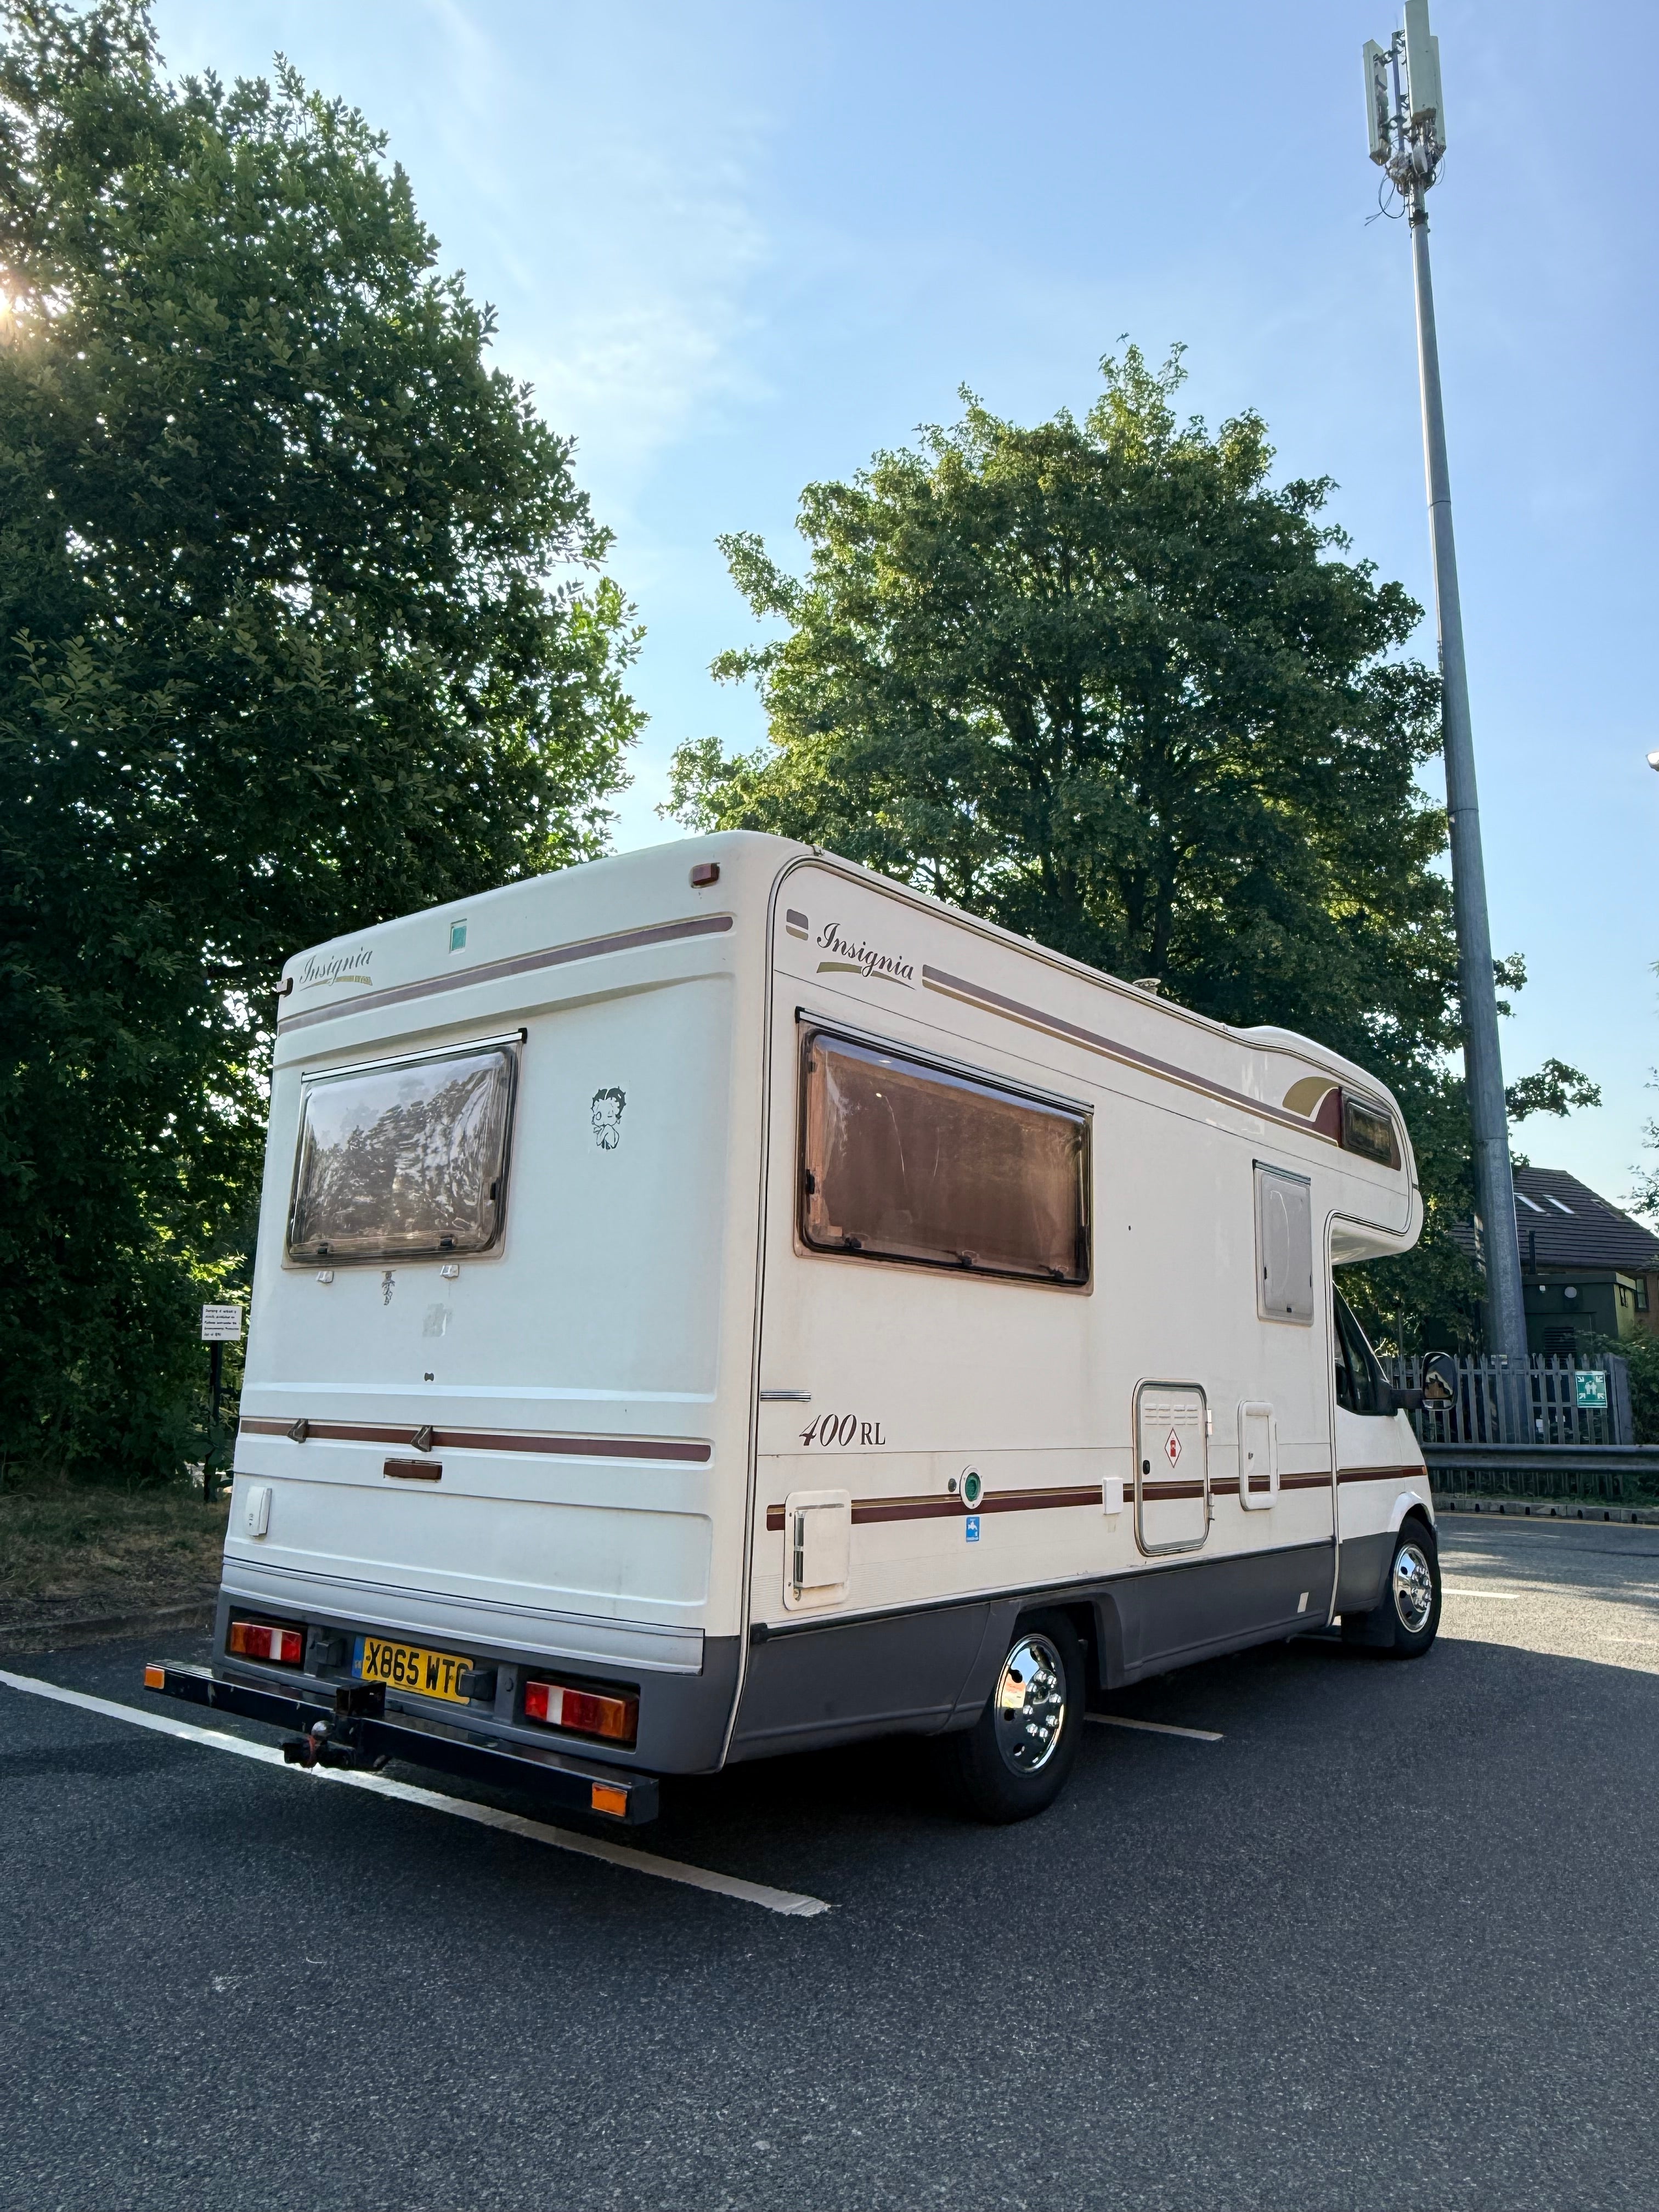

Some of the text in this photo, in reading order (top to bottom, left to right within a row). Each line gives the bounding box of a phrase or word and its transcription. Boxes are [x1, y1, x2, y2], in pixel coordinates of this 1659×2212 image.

[300, 946, 373, 986] Insignia
[817, 923, 914, 980] Insignia
[799, 1414, 885, 1446] 400 RL
[366, 1642, 420, 1685] X865
